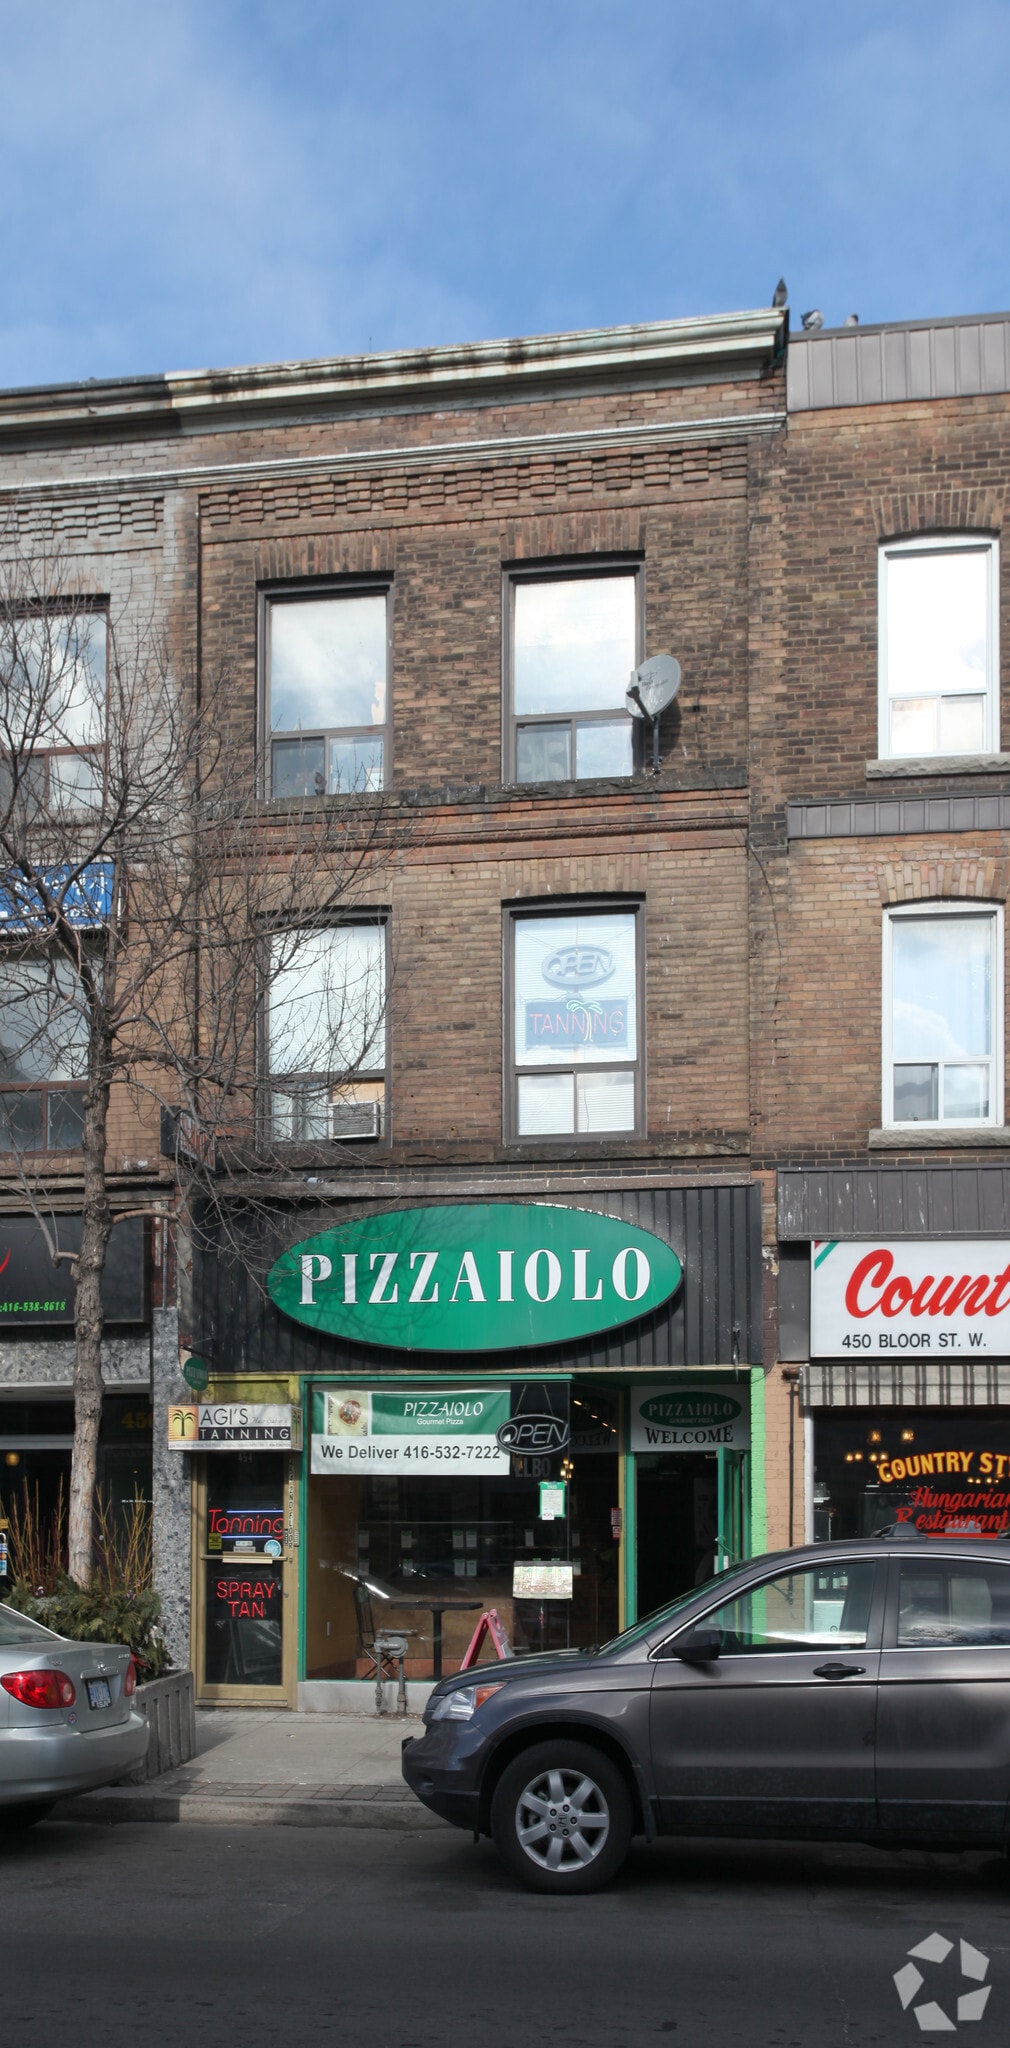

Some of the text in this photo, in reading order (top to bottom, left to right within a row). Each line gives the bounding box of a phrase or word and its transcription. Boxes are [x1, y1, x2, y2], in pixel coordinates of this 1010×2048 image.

[299, 1247, 651, 1305] PIZZAIOLO
[841, 1333, 987, 1348] 450 BLOOR ST. W.
[200, 1408, 249, 1426] AGI'S
[403, 1401, 484, 1417] PIZZAIOLO
[648, 1402, 734, 1417] PIZZAIOLO
[416, 1418, 464, 1427] Gourmet Pizza
[200, 1428, 290, 1440] TANNING
[500, 1423, 569, 1445] OPEN
[644, 1425, 734, 1444] WELCOME
[321, 1444, 501, 1459] We Deliver 416-532-7222
[878, 1450, 974, 1483] COUNTRY
[208, 1509, 284, 1540] Tanning
[216, 1581, 275, 1599] SPRAY
[227, 1601, 265, 1617] TAN
